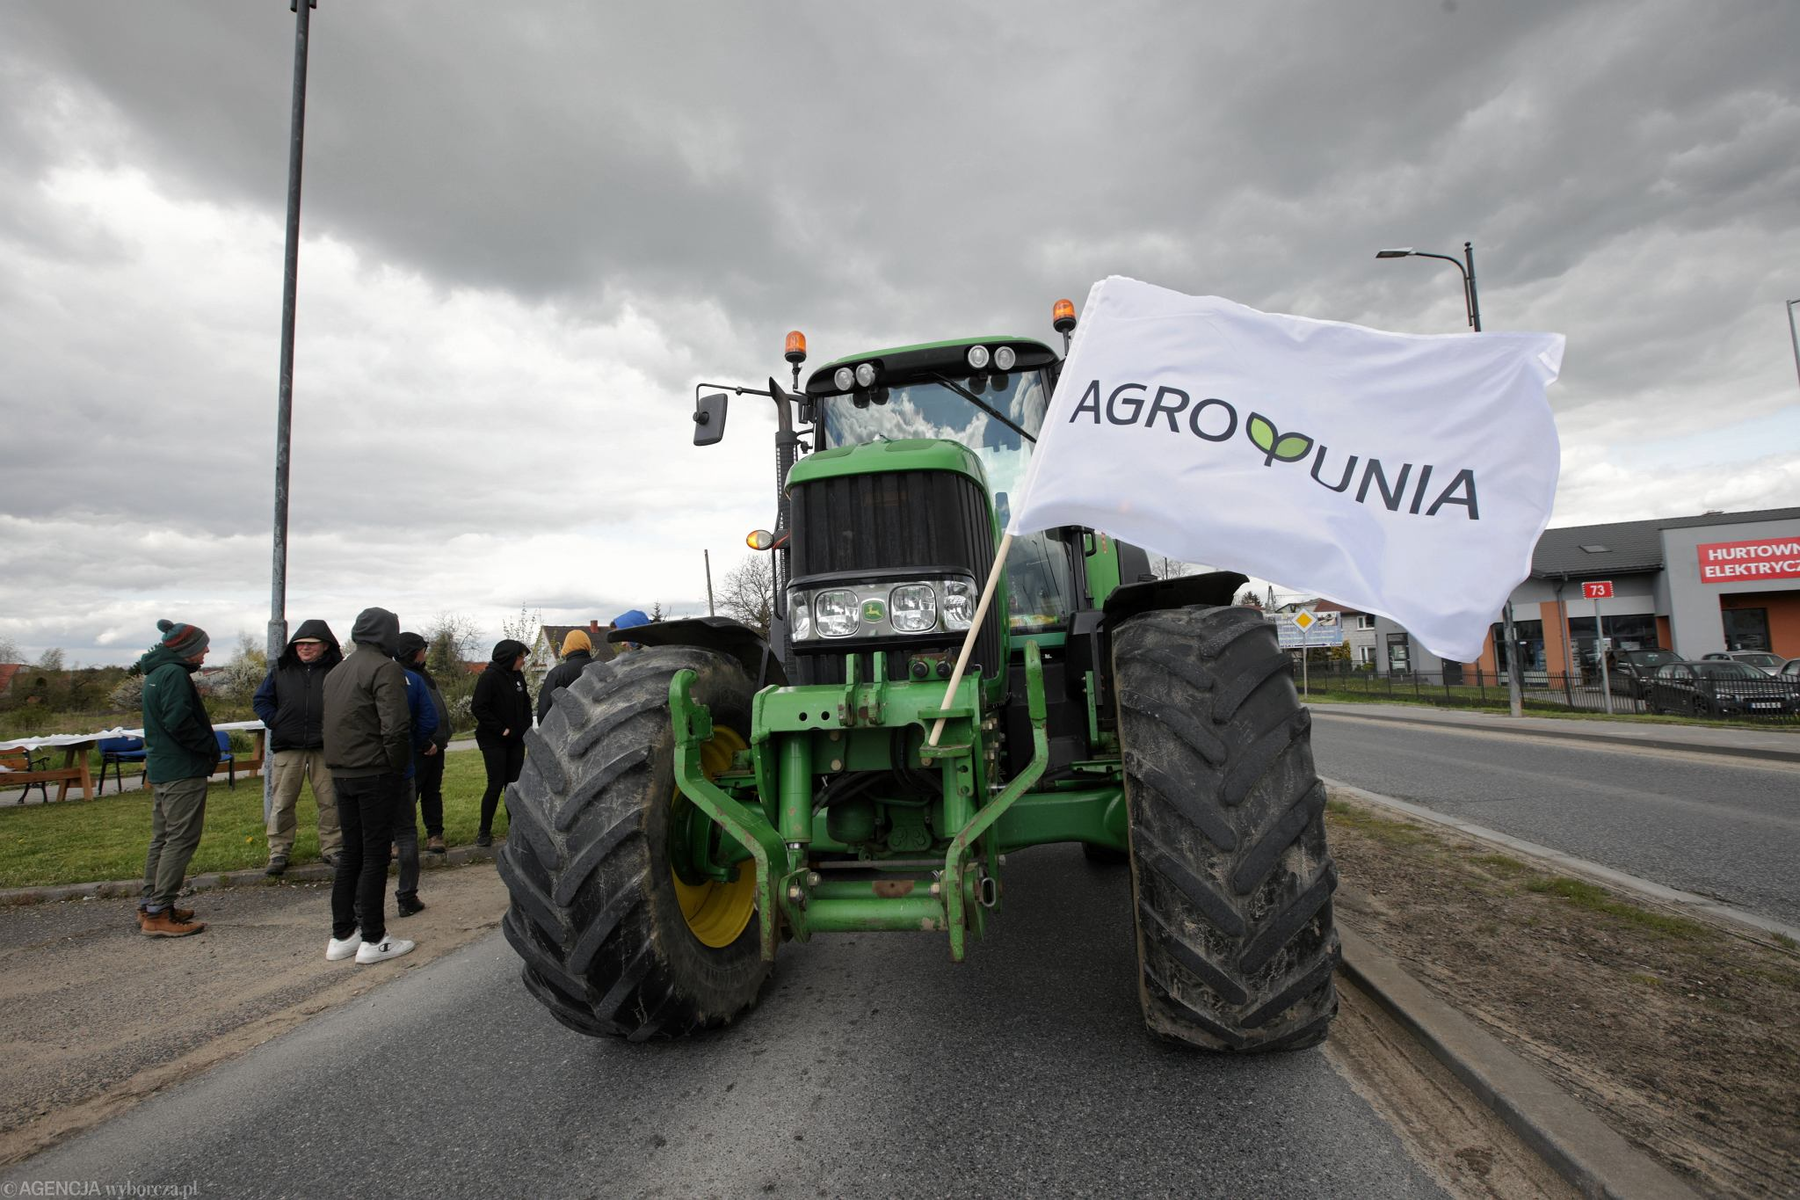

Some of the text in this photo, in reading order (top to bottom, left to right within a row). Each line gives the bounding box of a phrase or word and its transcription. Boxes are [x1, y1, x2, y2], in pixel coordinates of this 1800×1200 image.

[1068, 379, 1481, 521] AGRO UNIA
[1590, 584, 1605, 596] 73
